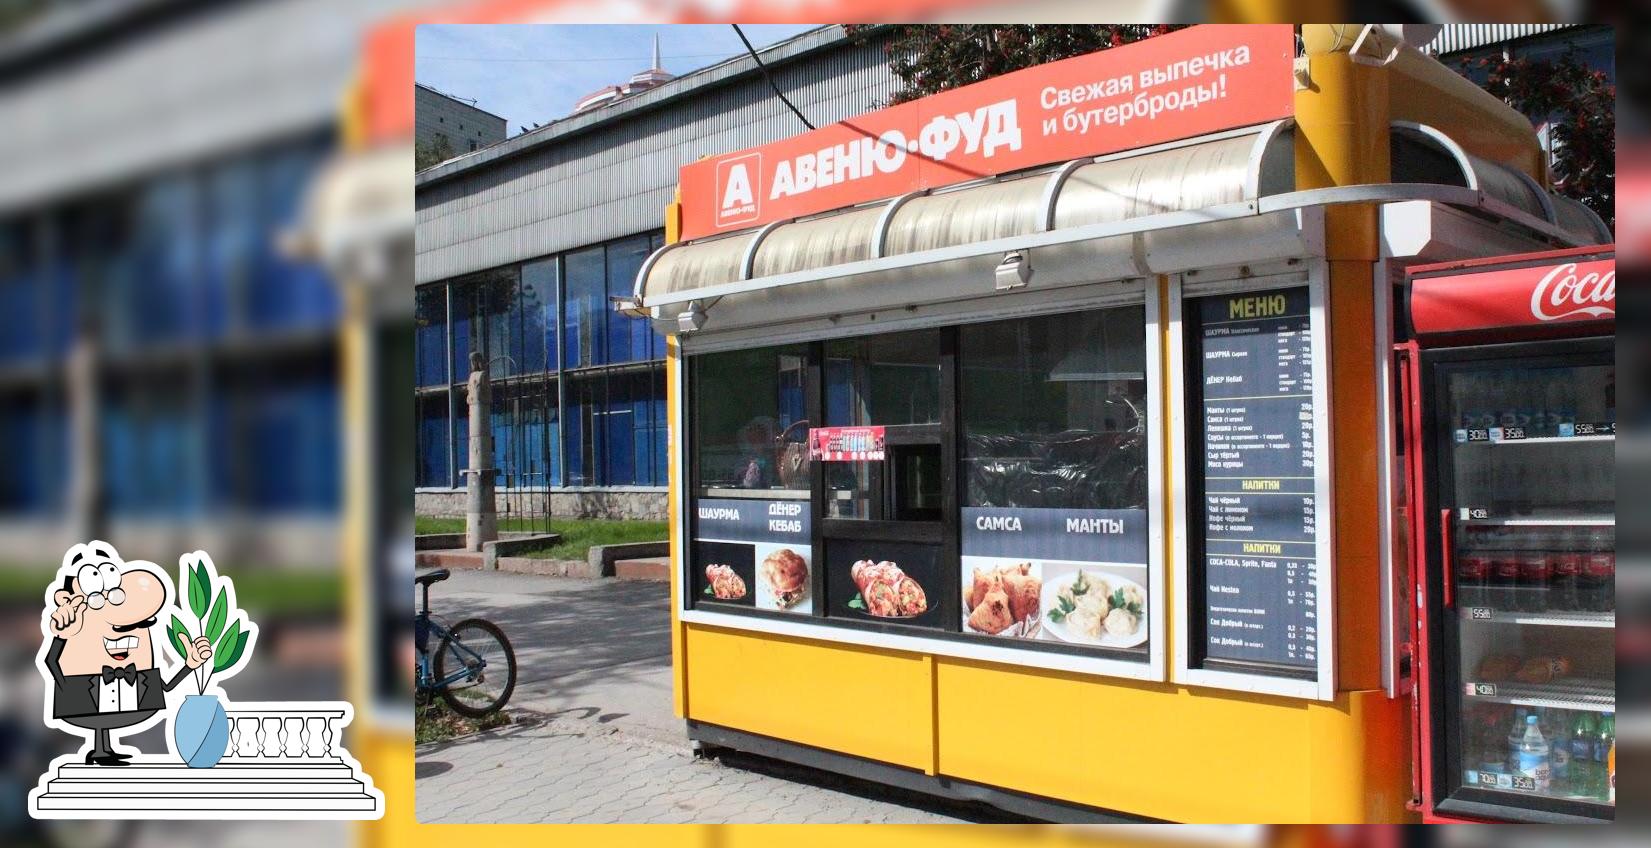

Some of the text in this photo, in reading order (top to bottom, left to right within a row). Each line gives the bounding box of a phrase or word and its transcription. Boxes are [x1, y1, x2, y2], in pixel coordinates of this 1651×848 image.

[1040, 45, 1250, 109] Свежая выпечка
[1043, 74, 1226, 136] и бутерброды!
[722, 163, 753, 209] А
[1229, 294, 1286, 319] МЕНЮ
[1205, 351, 1230, 359] ШАУРМА
[1242, 480, 1280, 490] НАПИТКИ
[698, 508, 740, 520] ШАУРМА
[769, 501, 802, 516] ДЁНЕР
[769, 520, 802, 532] КЕБАБ
[976, 516, 1022, 531] САМСА
[1066, 518, 1124, 534] МАНТЫ
[1243, 543, 1281, 554] НАПИТКИ
